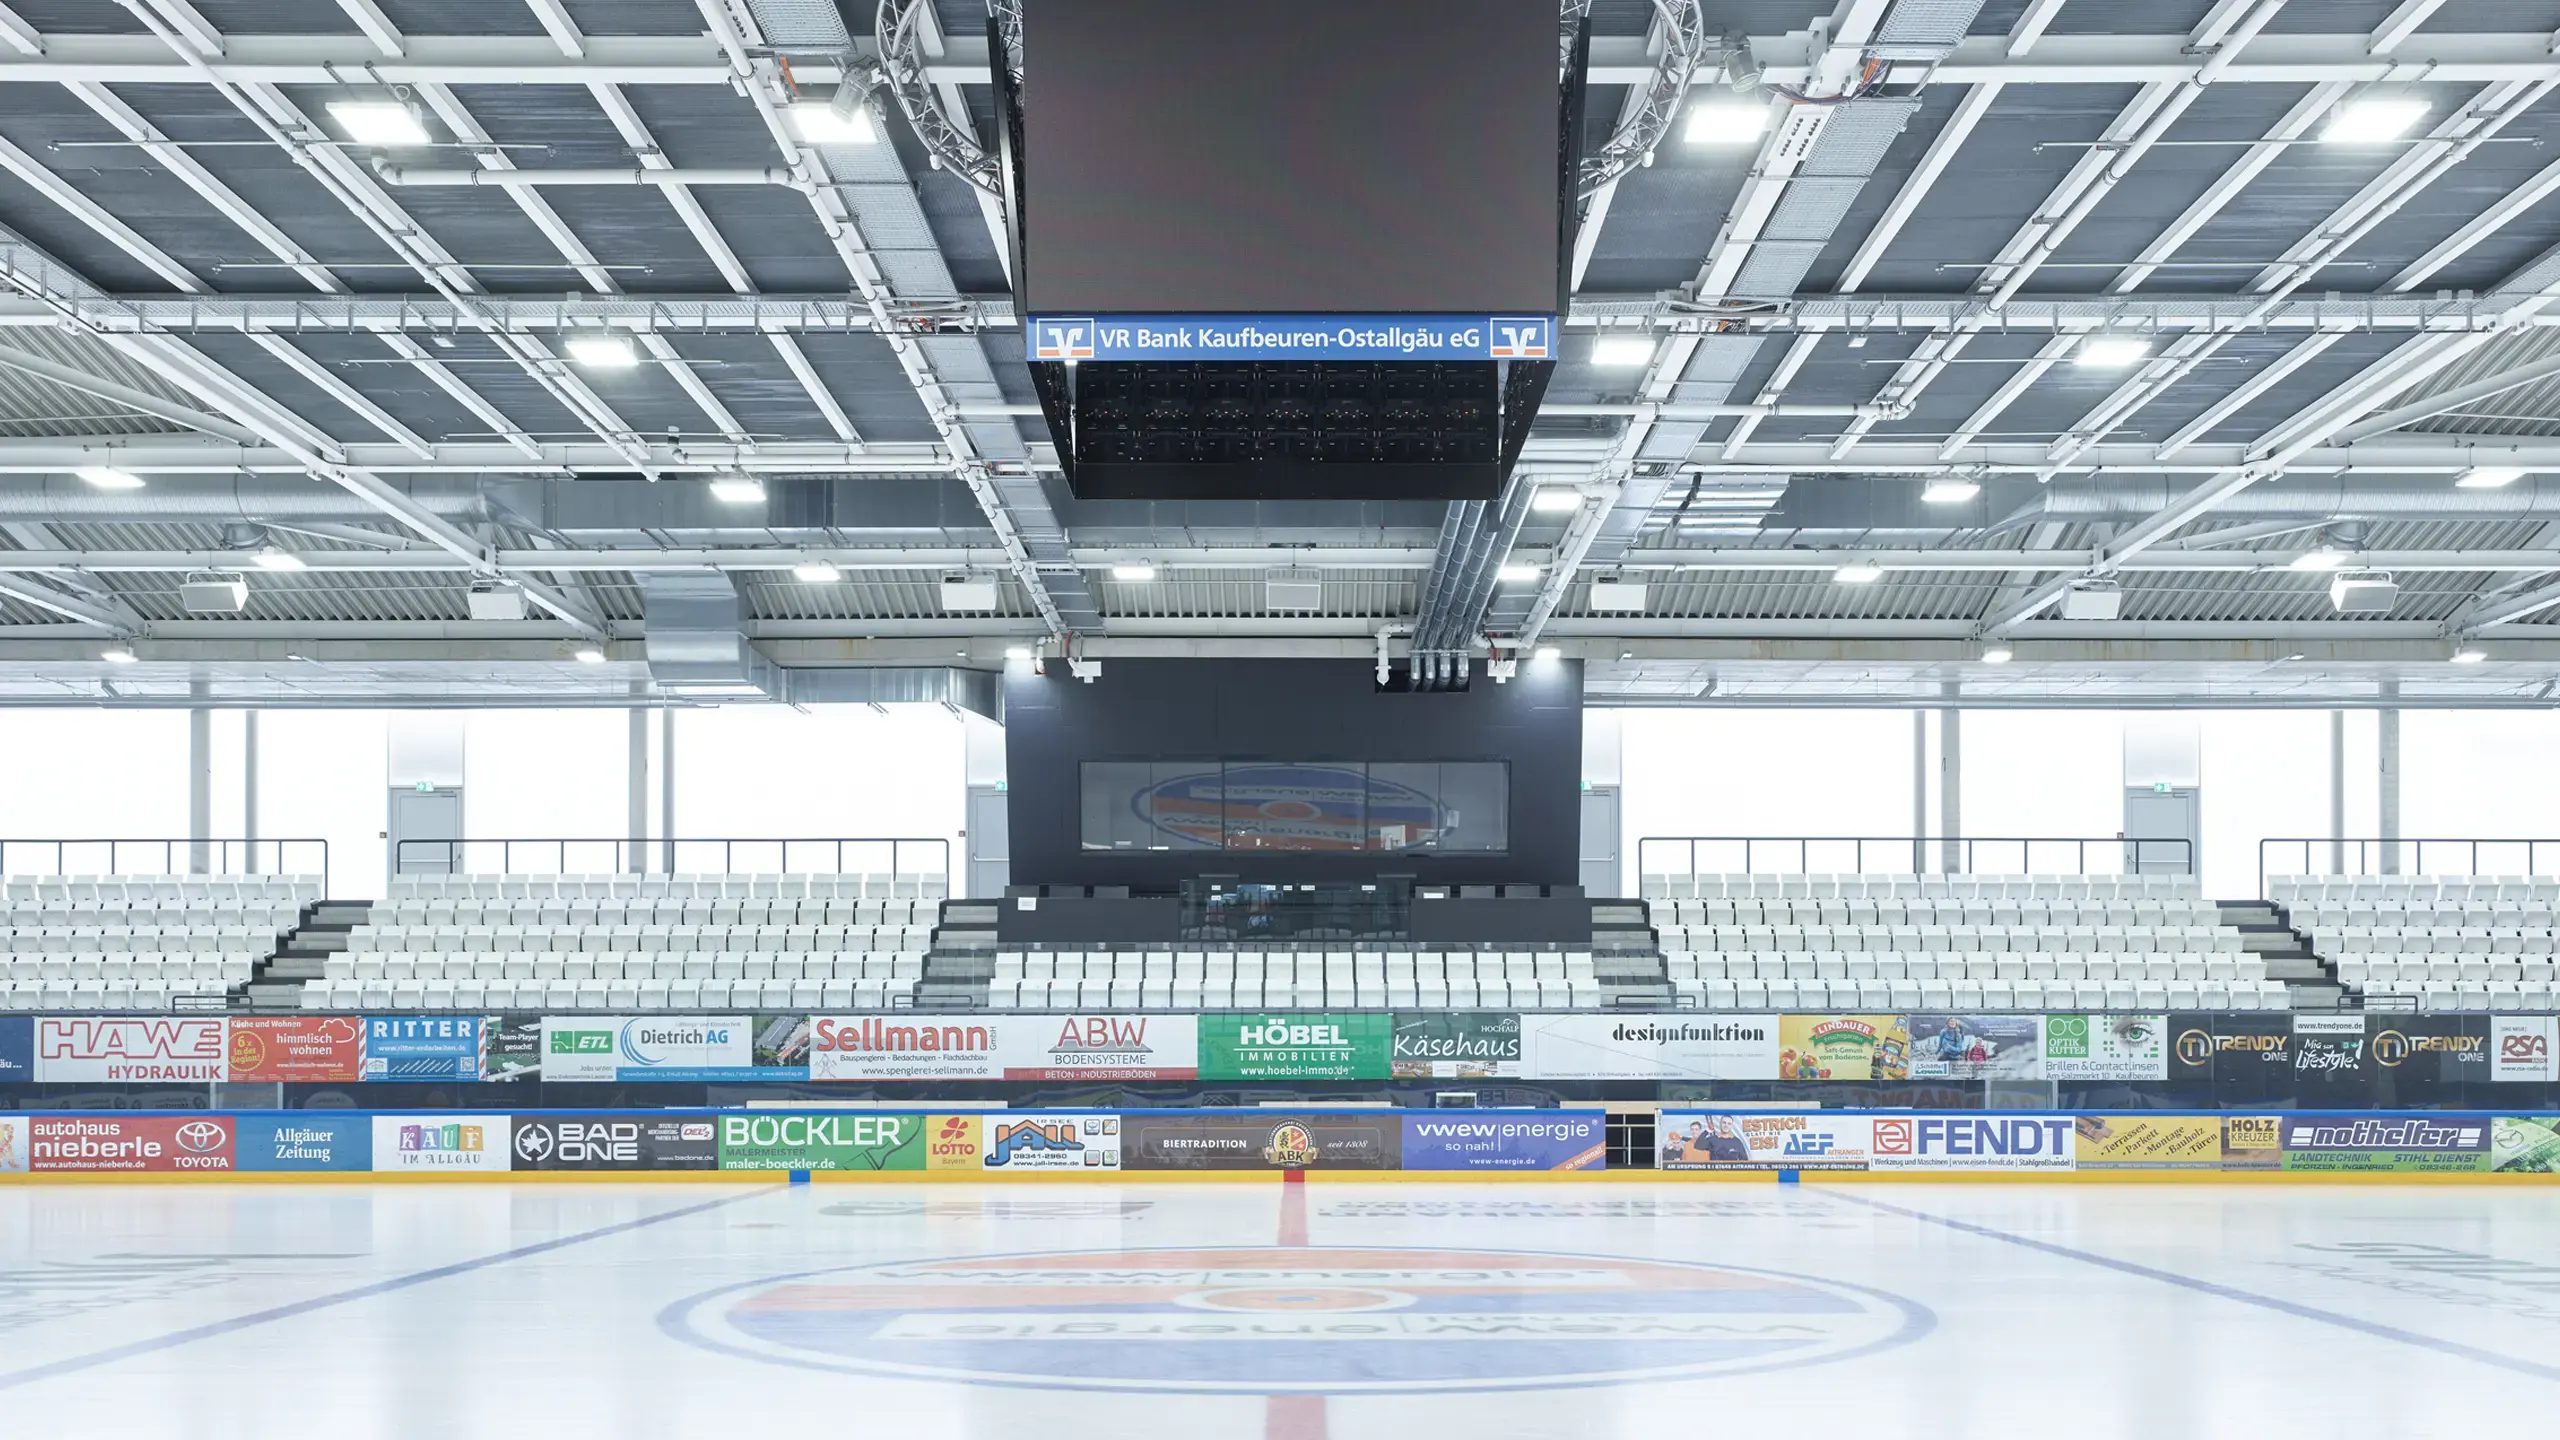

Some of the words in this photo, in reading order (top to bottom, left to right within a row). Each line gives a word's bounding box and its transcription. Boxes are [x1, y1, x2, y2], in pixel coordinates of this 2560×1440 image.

[1100, 329, 1132, 348] VR
[1137, 329, 1192, 348] Bank
[1199, 328, 1443, 352] Kaufbeuren-Ostallgäu
[1450, 329, 1480, 348] eG
[231, 1020, 253, 1028] Küche
[255, 1020, 269, 1028] und
[271, 1020, 301, 1028] Wohnen
[373, 1021, 471, 1037] RITTER
[1817, 1021, 1870, 1034] LINDAUER
[2297, 1022, 2363, 1030] www.trendyone.de
[641, 1029, 703, 1044] Dietrich
[706, 1029, 728, 1044] AG
[816, 1018, 988, 1051] Sellmann
[989, 1026, 997, 1050] GmbH
[1057, 1017, 1147, 1047] ABW
[1240, 1018, 1348, 1045] HÖBEL
[1612, 1023, 1765, 1046] designfunktion
[41, 1021, 221, 1059] HAWE
[237, 1036, 246, 1047] 6
[276, 1033, 332, 1044] himmlisch
[578, 1036, 609, 1049] ETL
[1393, 1032, 1518, 1056] Käsehaus
[2049, 1038, 2079, 1047] OPTIK
[2213, 1035, 2288, 1051] TRENDY
[2304, 1038, 2321, 1049] Mia
[2409, 1036, 2484, 1051] TRENDY
[289, 1045, 332, 1055] wohnen
[504, 1043, 533, 1051] gesucht!
[2049, 1047, 2087, 1055] KUTTER
[2501, 1035, 2548, 1057] RSA
[840, 1054, 886, 1062] Bauspenglerei
[893, 1054, 936, 1062] Bedachungen
[943, 1054, 988, 1062] Flachdachbau
[1055, 1054, 1146, 1065] BODENSYSTEME
[1240, 1052, 1349, 1061] IMMOBILIEN
[2262, 1052, 2288, 1061] ONE
[2458, 1052, 2484, 1062] ONE
[108, 1066, 222, 1079] HYDRAULIK
[862, 1066, 988, 1076] www.spenglerei-sellmann.de
[2046, 1062, 2079, 1071] Brillen
[2081, 1062, 2089, 1071] &
[1045, 1070, 1074, 1079] BETON
[1081, 1069, 1156, 1079] INDUSTRIEBÖDEN
[34, 1120, 120, 1136] autohaus
[725, 1116, 902, 1146] BÖCKLER
[1742, 1117, 1807, 1132] ESTRICH
[2231, 1120, 2274, 1132] HOLZ
[274, 1128, 333, 1144] Allgäuer
[558, 1123, 638, 1141] BAD
[1918, 1120, 2073, 1155] FENDT
[2103, 1122, 2148, 1153] Terrassen
[2231, 1133, 2274, 1141] KREUZER
[2313, 1120, 2458, 1147] nothelfer
[401, 1129, 480, 1149] KAUF
[1163, 1139, 1247, 1149] BIERTRADITION
[1750, 1136, 1779, 1150] EIS!
[1783, 1134, 1834, 1155] AEF
[2125, 1128, 2160, 1154] Parkett
[2146, 1126, 2185, 1154] Montage
[2168, 1127, 2205, 1154] Bauholz
[2189, 1133, 2218, 1154] Türen
[34, 1136, 162, 1157] nieberle
[558, 1142, 638, 1161] ONE
[932, 1143, 975, 1155] LOTTO
[1445, 1143, 1461, 1151] so
[1465, 1141, 1494, 1151] nah!
[276, 1145, 330, 1161] Zeitung
[403, 1154, 419, 1164] IM
[426, 1152, 481, 1164] ALLGÄU
[726, 1149, 806, 1157] MALERMEISTER
[1278, 1151, 1304, 1161] ABK
[1565, 1162, 1574, 1170] so
[1574, 1147, 1603, 1166] regional!
[2292, 1154, 2372, 1162] LANDTECHNIK
[2394, 1154, 2430, 1162] STIHL
[2433, 1154, 2481, 1162] DIENST
[35, 1161, 146, 1169] www.autohaus-nieberle.de
[173, 1157, 229, 1168] TOYOTA
[726, 1158, 835, 1169] maler-boeckler.de
[942, 1157, 966, 1165] Bayern
[1469, 1157, 1536, 1165] vwew-energie.de
[1874, 1158, 1903, 1167] Werkzeug
[1952, 1158, 2015, 1166] www.eisen-fendt.de
[2019, 1158, 2070, 1167] Stahlgroßhandel
